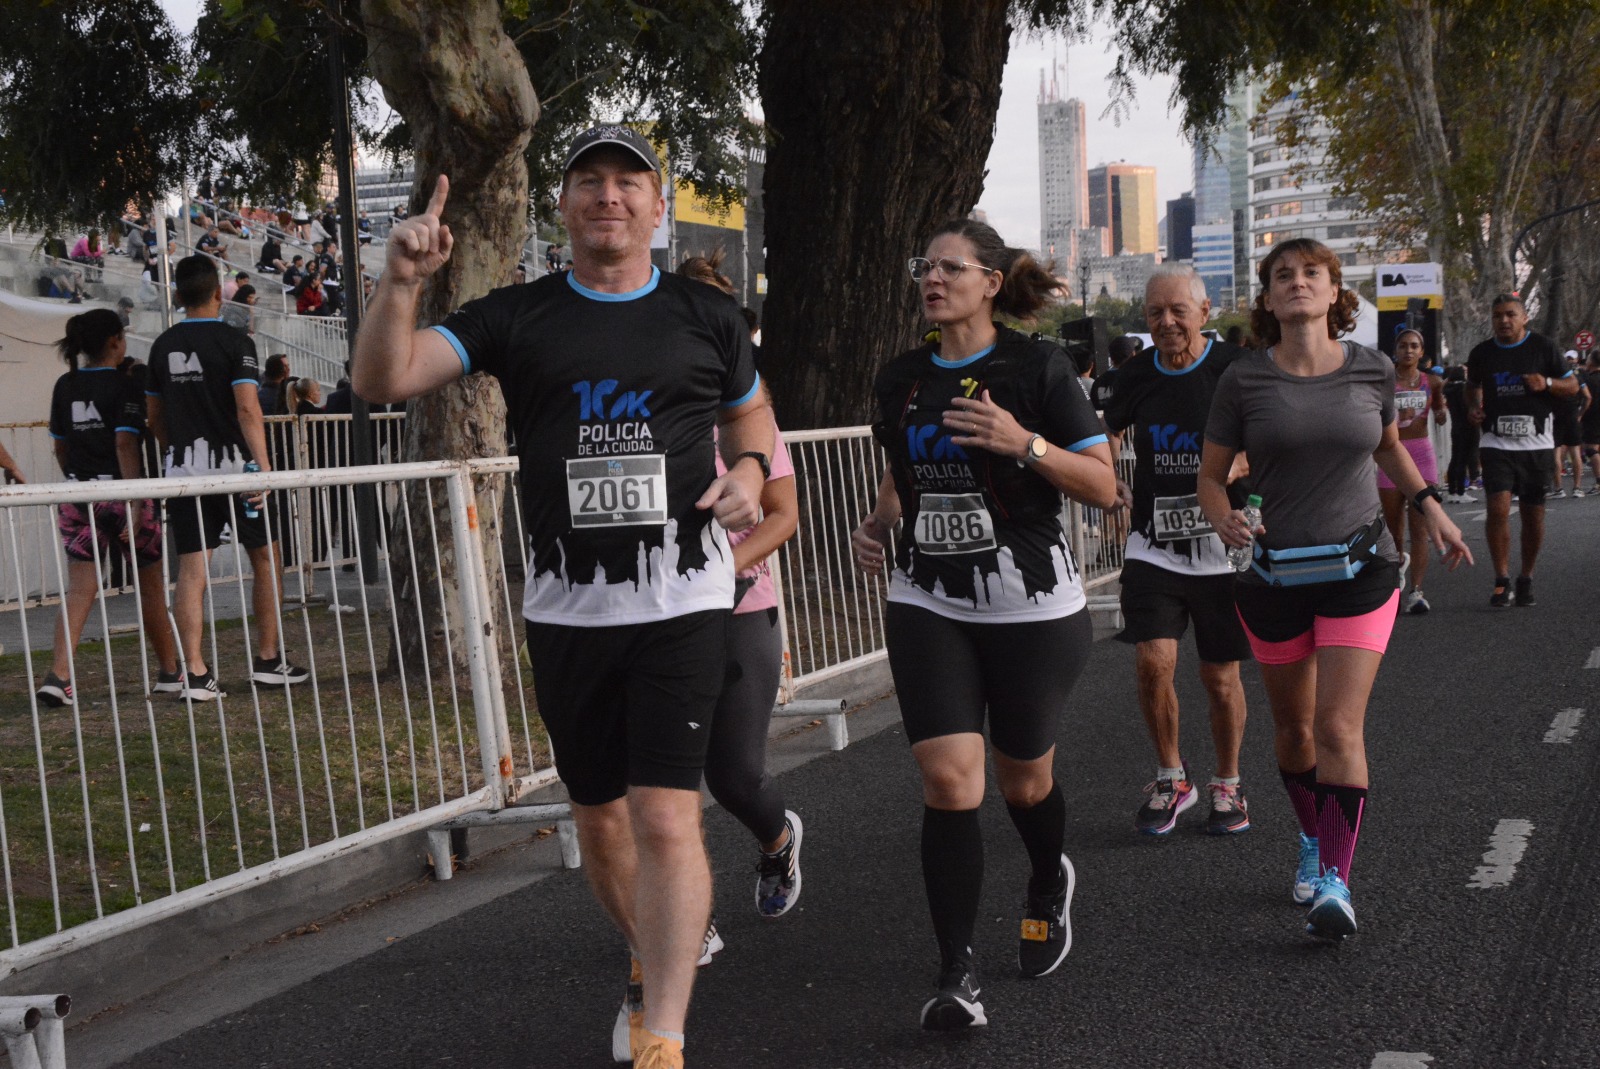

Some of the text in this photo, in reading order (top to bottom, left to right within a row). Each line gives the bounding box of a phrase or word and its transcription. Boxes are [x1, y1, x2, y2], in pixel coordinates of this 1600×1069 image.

[1382, 273, 1407, 287] BA
[168, 351, 203, 375] BA
[71, 400, 102, 423] BA
[579, 422, 653, 443] POLICIA
[1501, 422, 1529, 434] 1455
[578, 440, 654, 456] DE LA CIUDAD
[1154, 453, 1201, 466] POLICIA
[913, 463, 974, 480] POLICIA
[1154, 466, 1163, 475] DE
[1164, 466, 1174, 475] LA
[577, 477, 656, 513] 2061
[921, 512, 985, 543] 1086
